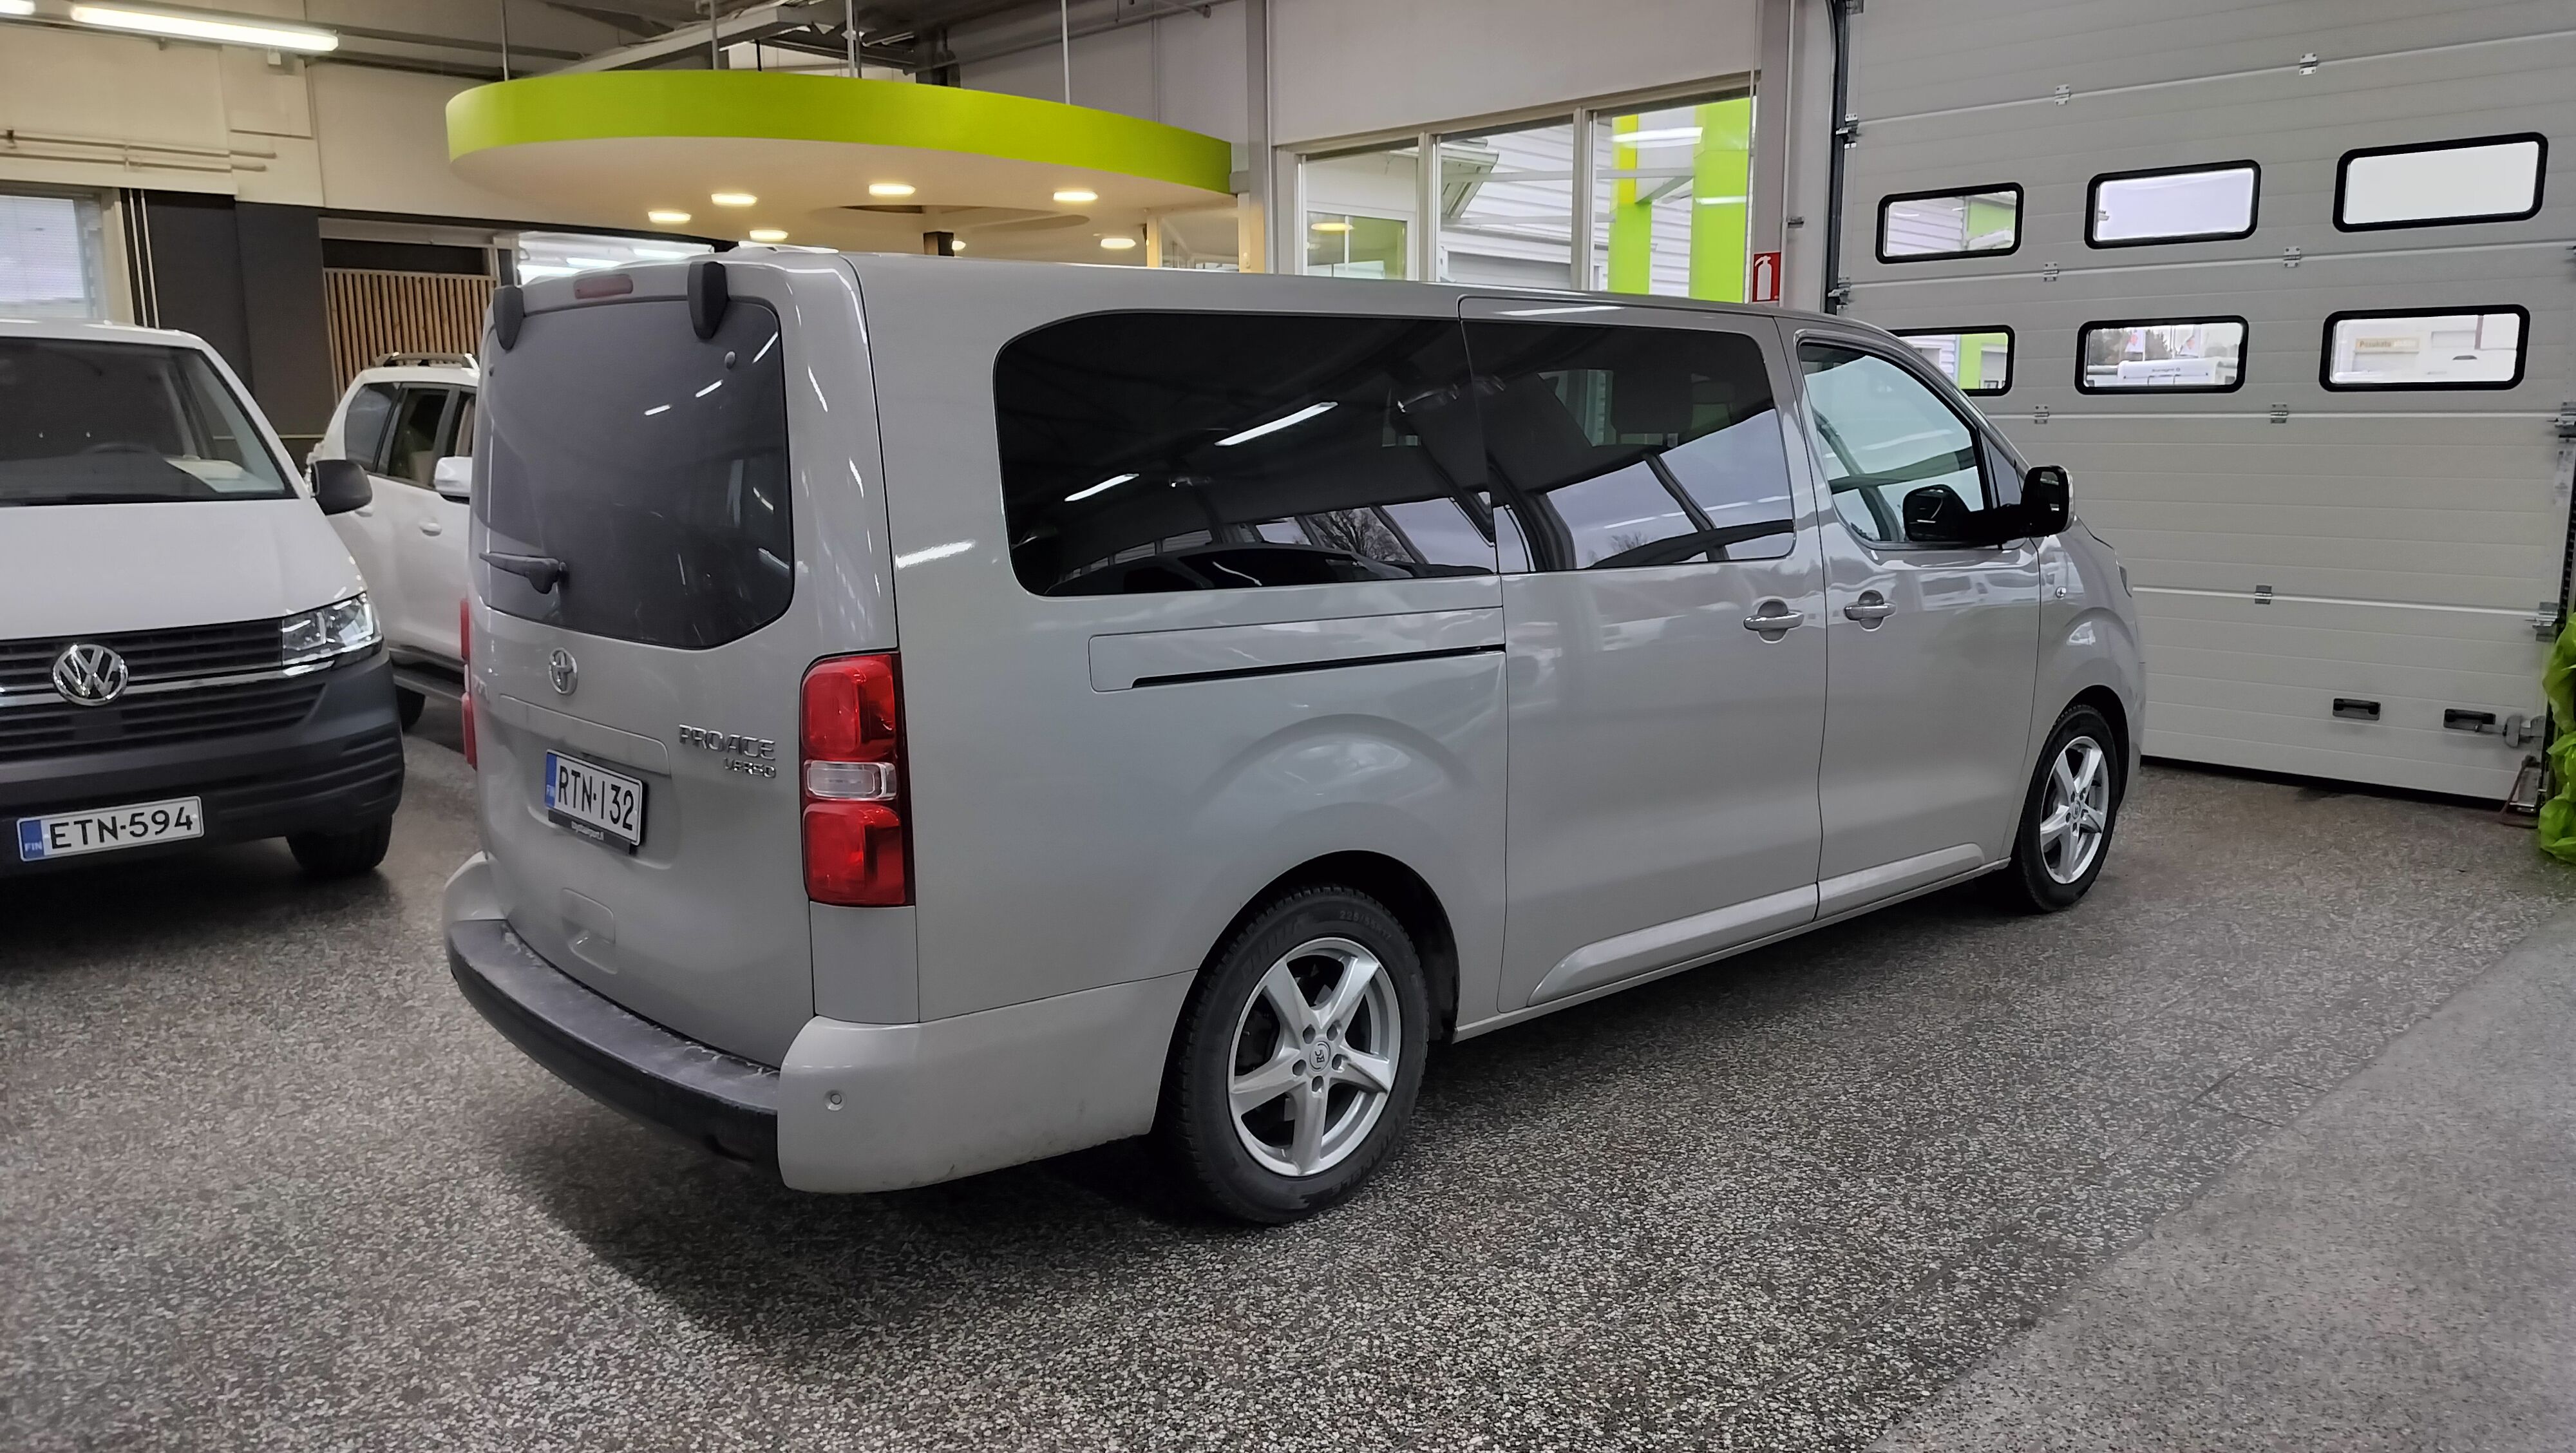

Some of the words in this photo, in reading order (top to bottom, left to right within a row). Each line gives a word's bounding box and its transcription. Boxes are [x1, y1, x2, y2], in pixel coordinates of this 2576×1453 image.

[679, 724, 776, 761] PROACE
[723, 757, 777, 778] VERSO
[558, 765, 635, 831] RTN-132
[24, 840, 43, 851] FIN
[50, 806, 193, 850] ETN-594
